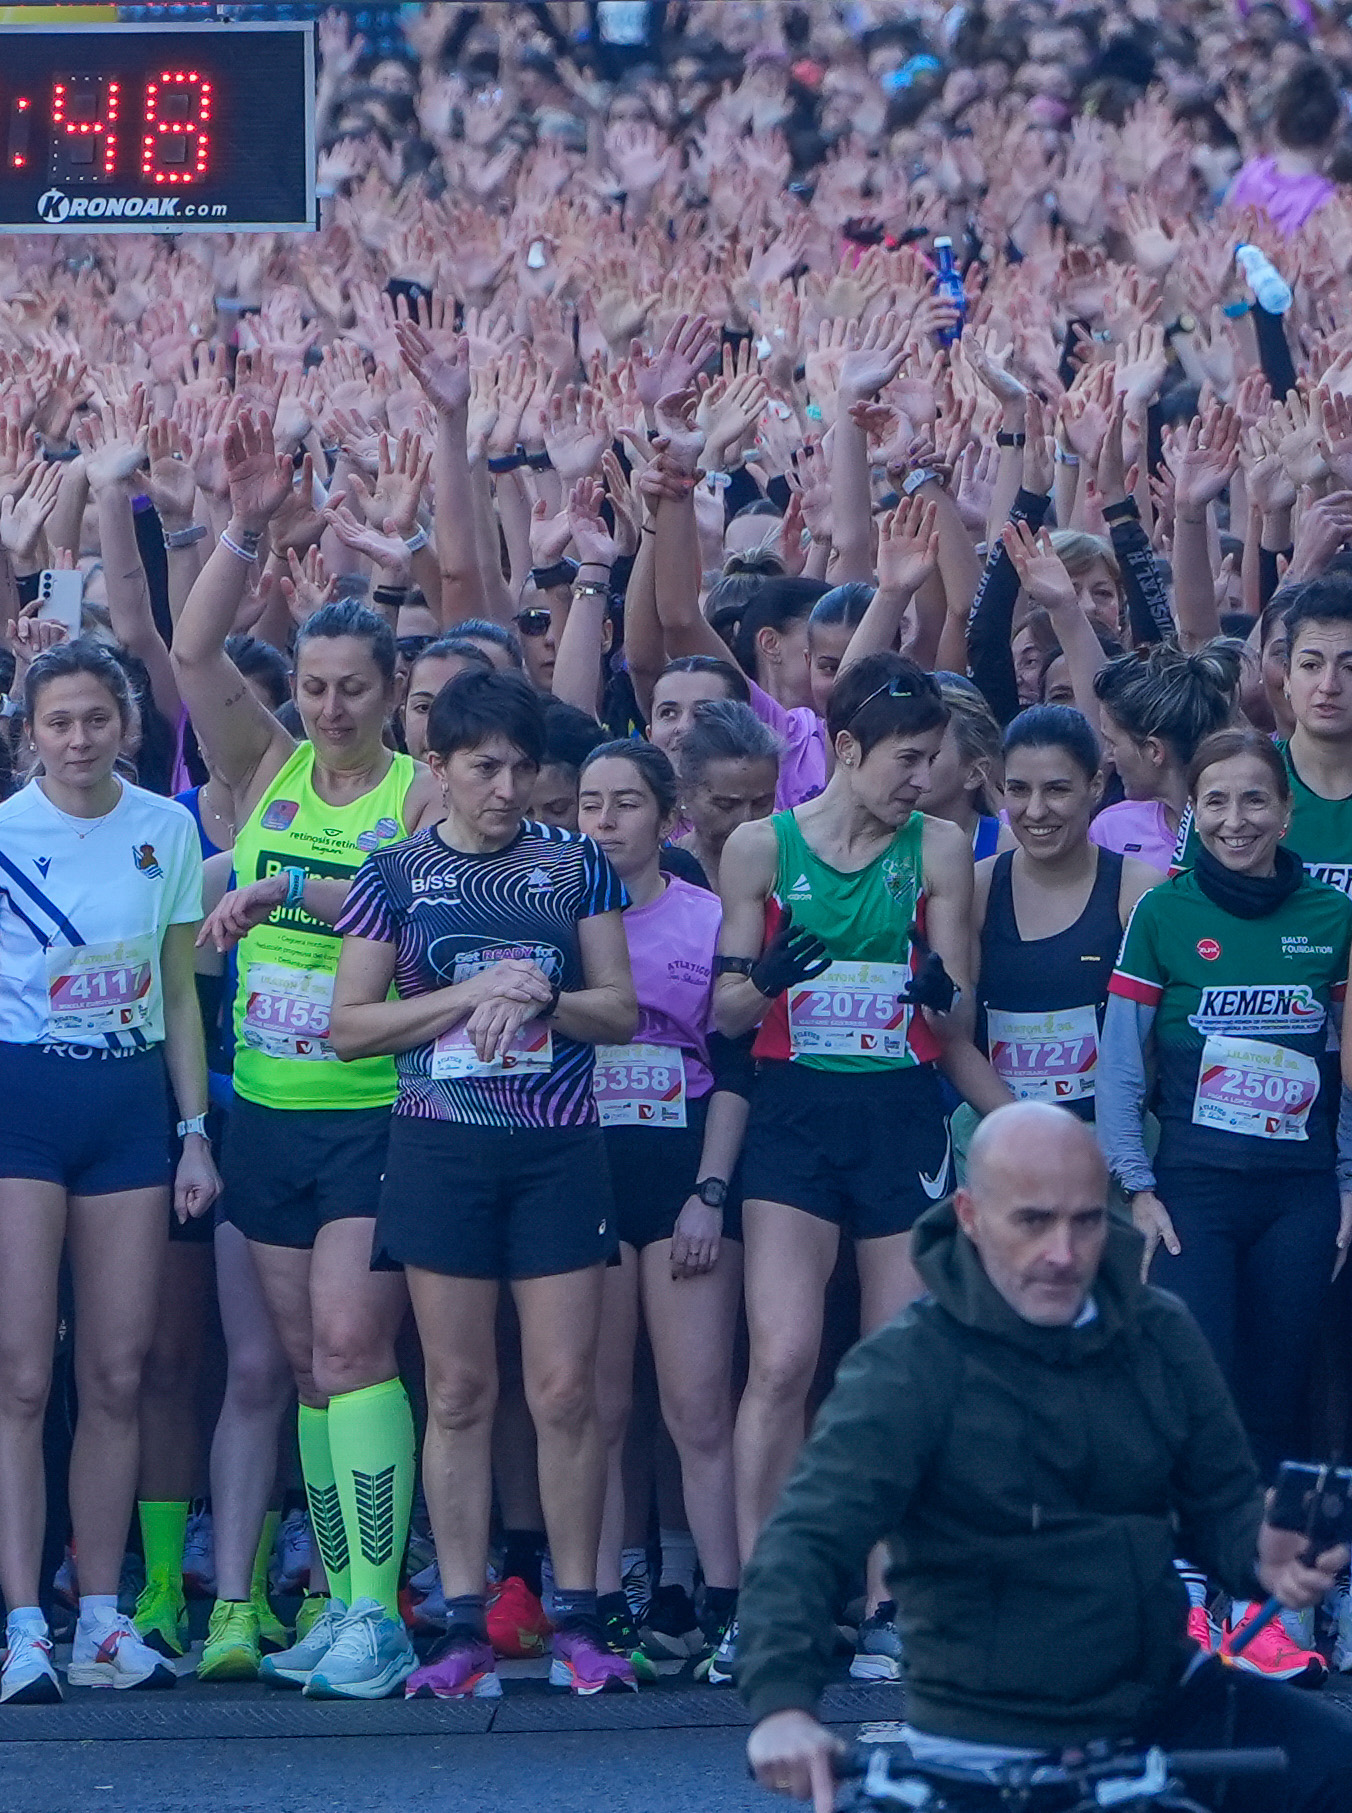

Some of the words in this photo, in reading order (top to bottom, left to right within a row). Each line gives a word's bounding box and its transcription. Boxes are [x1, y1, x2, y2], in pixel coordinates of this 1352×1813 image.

[332, 838, 358, 850] retin
[482, 946, 533, 961] READY
[1282, 945, 1333, 954] FOUNDATION
[70, 966, 143, 999] 4117
[256, 994, 331, 1030] 3155
[810, 992, 895, 1019] 2075
[1202, 990, 1294, 1016] KEMEN
[1005, 1040, 1084, 1067] 1727
[594, 1066, 670, 1092] 5358
[1220, 1070, 1304, 1105] 2508
